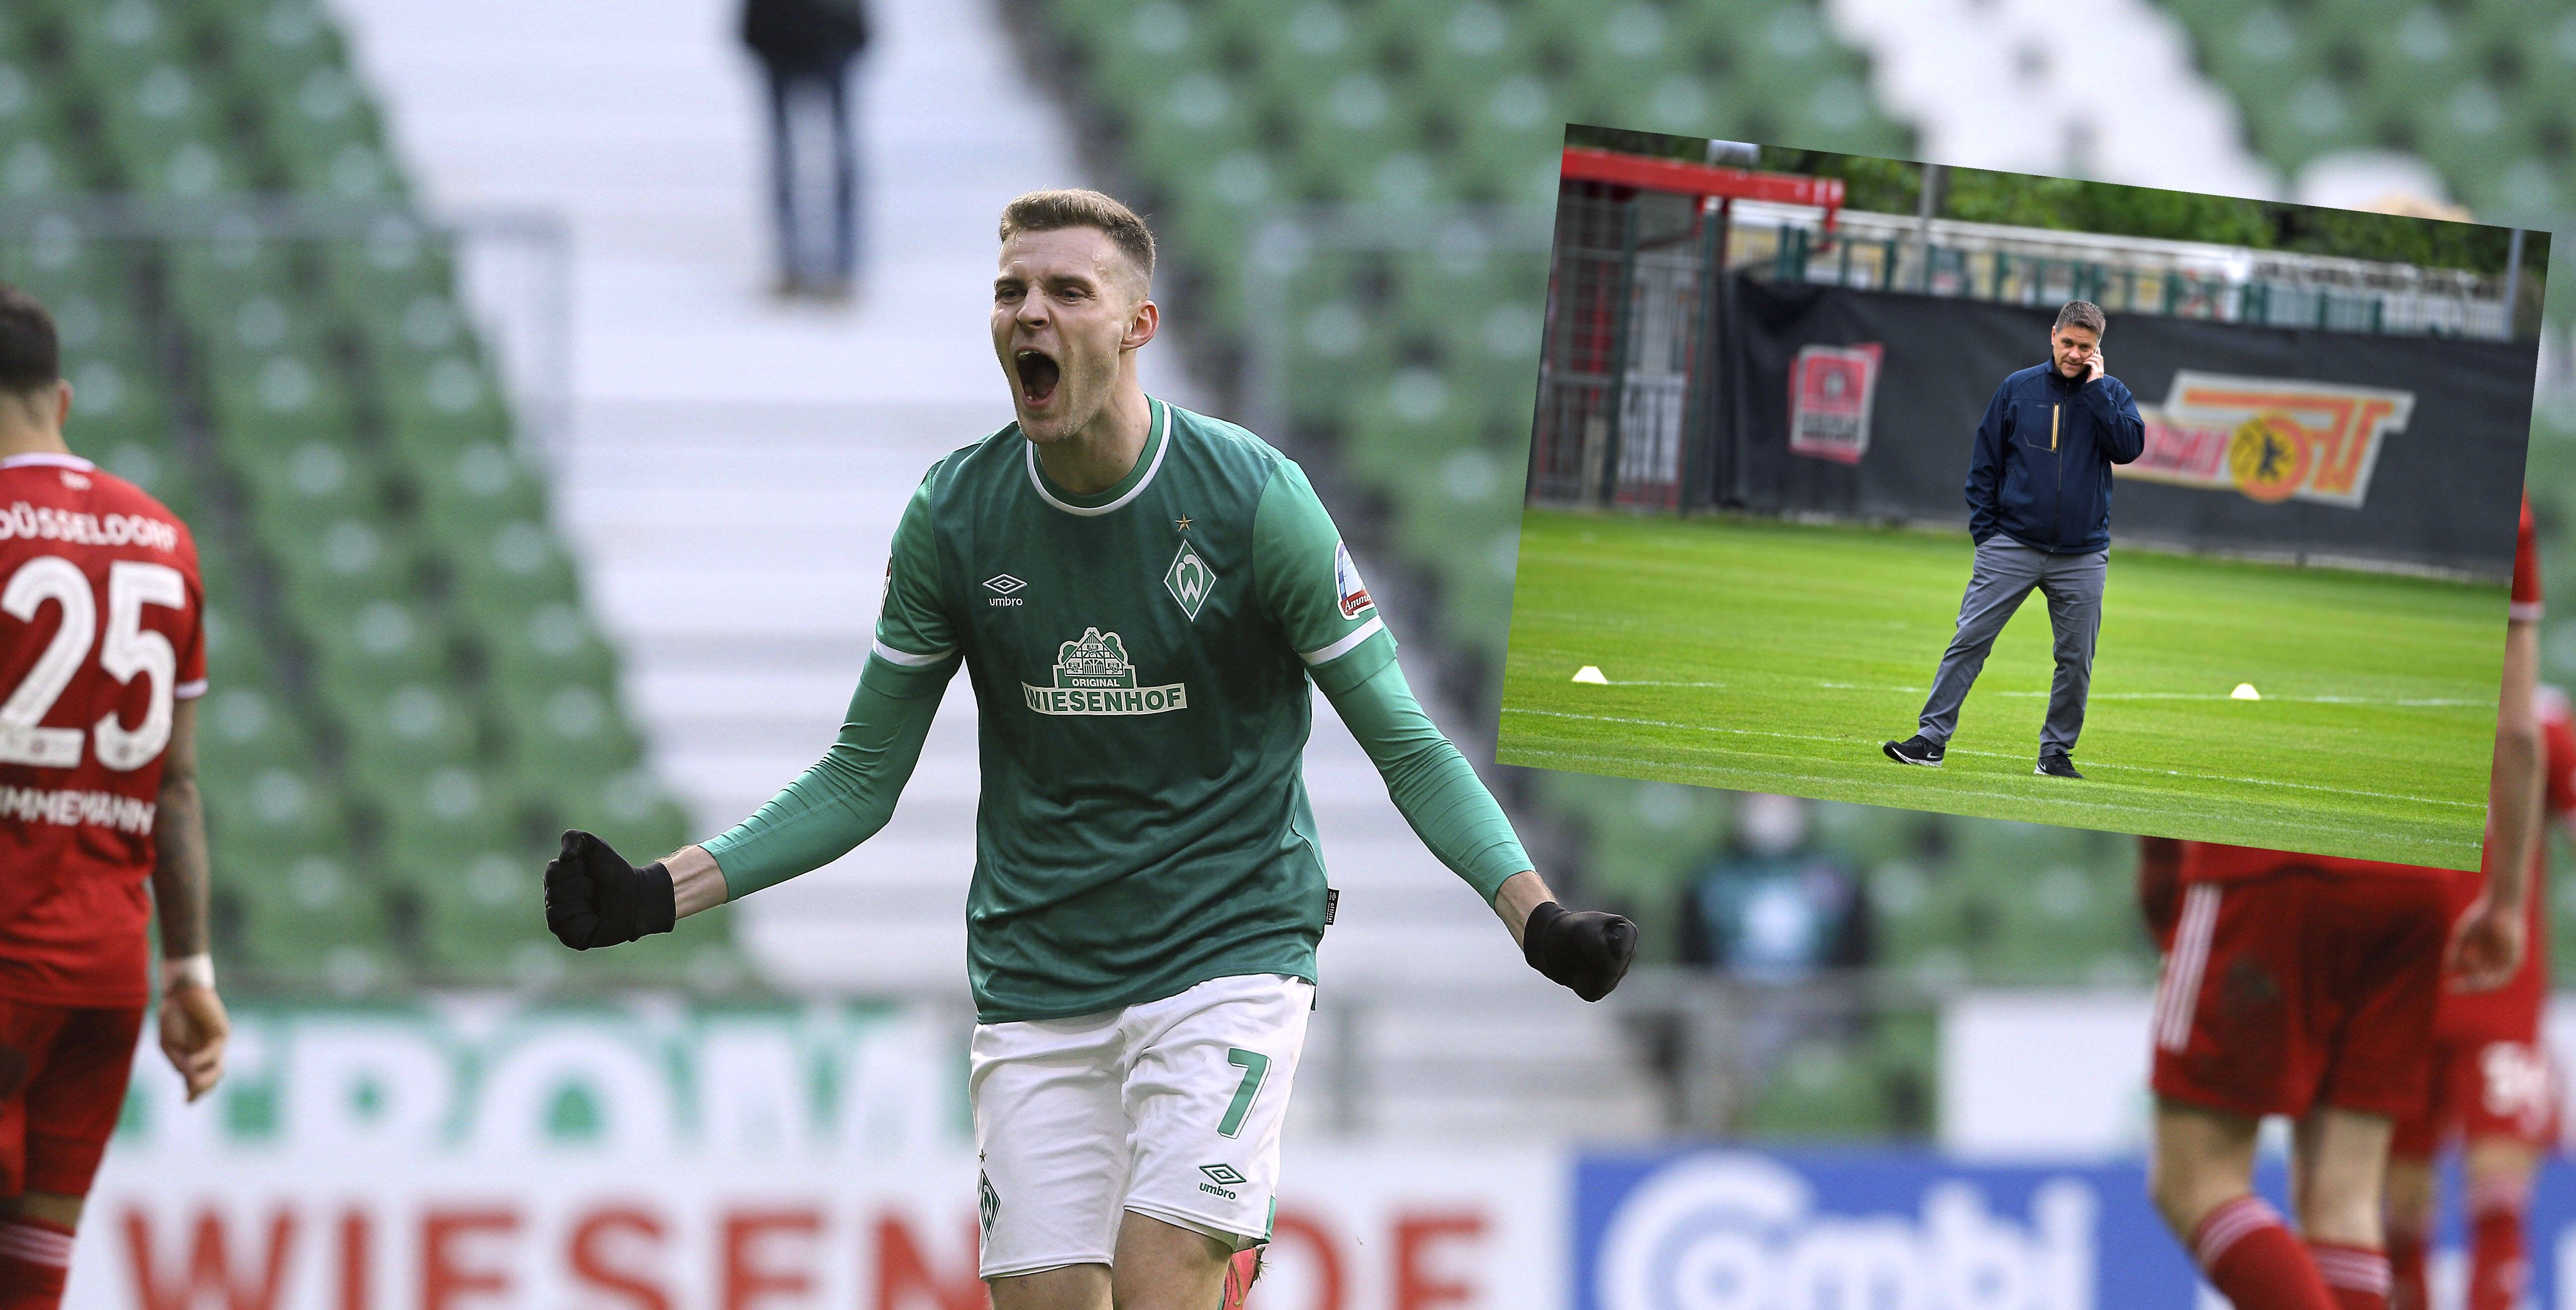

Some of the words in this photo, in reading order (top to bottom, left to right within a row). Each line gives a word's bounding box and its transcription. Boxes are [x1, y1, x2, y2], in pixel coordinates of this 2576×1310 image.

[989, 596, 1023, 607] umbro
[0, 554, 185, 771] 25
[1072, 678, 1120, 687] ORIGINAL
[1025, 687, 1181, 712] WIESENHOF
[1217, 1047, 1272, 1140] 7
[1199, 1182, 1236, 1200] umbro
